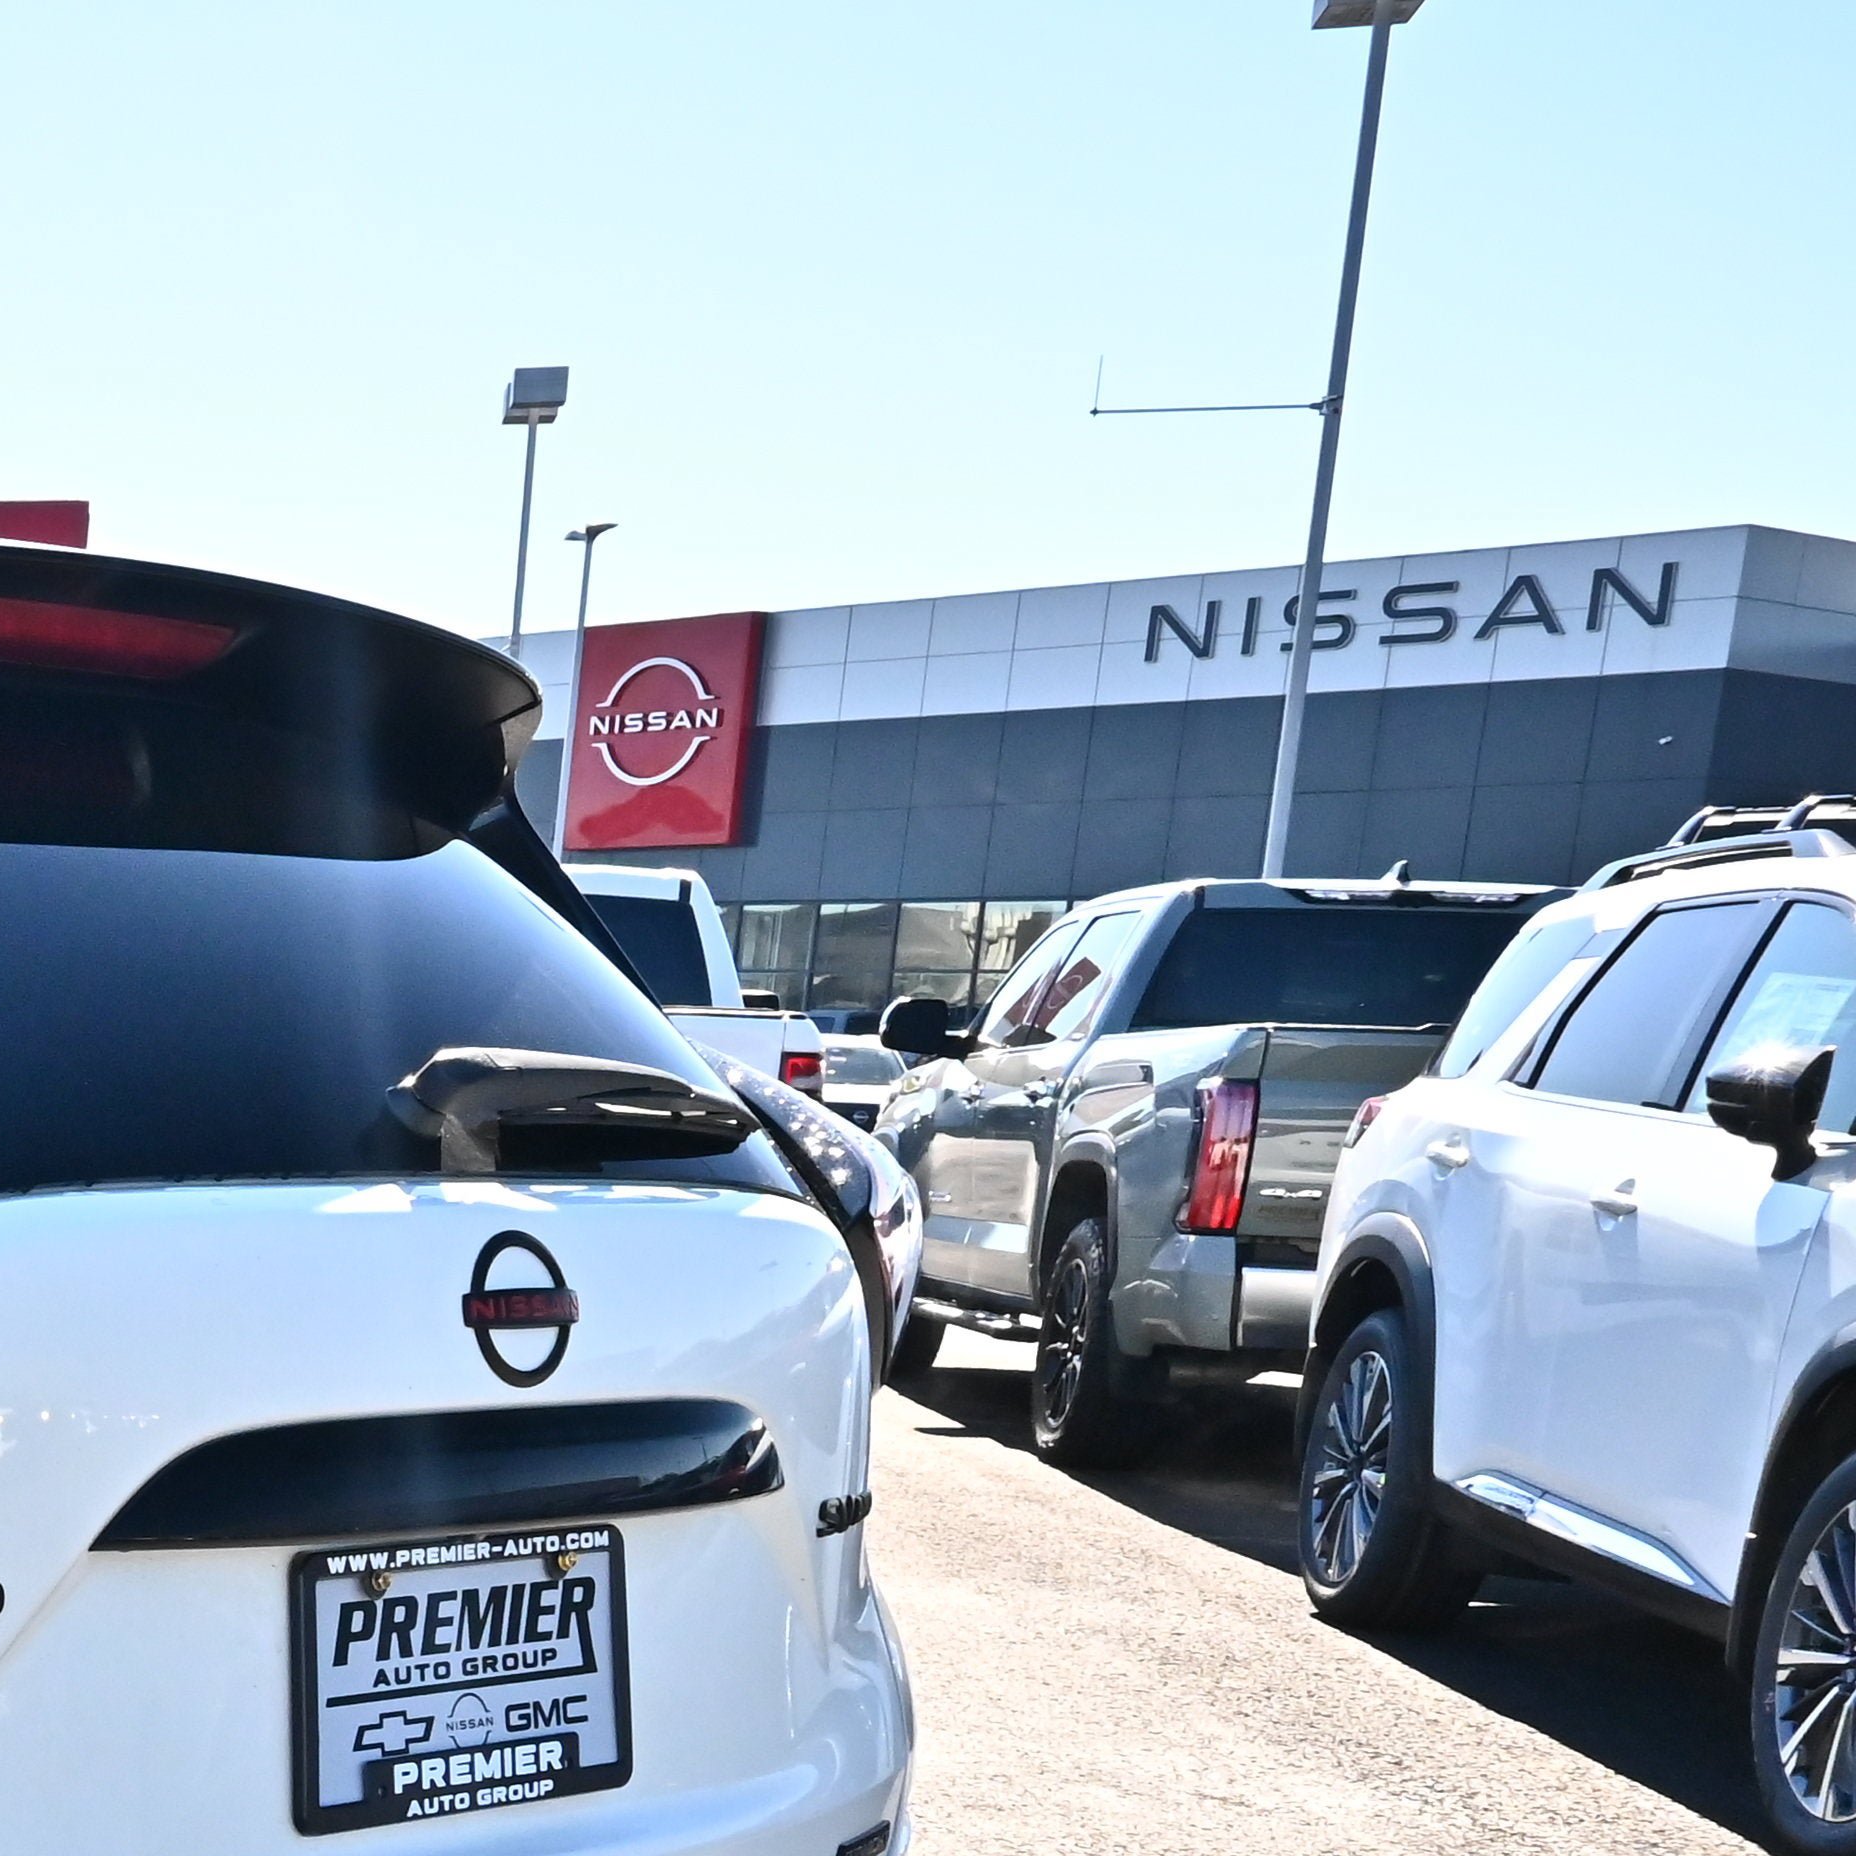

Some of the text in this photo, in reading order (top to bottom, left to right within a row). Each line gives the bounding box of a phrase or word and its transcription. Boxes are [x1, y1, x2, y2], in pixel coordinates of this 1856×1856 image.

[1143, 561, 1680, 664] NISSAN
[589, 708, 718, 735] NISSAN
[470, 1294, 579, 1322] NISSAN
[327, 1530, 609, 1574] WWW.PREMIER-AUTO.COM
[332, 1576, 598, 1667] PREMIER
[373, 1648, 557, 1687] AUTO GROUP
[446, 1717, 494, 1731] NISSAN
[505, 1695, 588, 1732] GMC
[393, 1740, 563, 1795] PREMIER
[406, 1779, 554, 1817] AUTO GROUP
